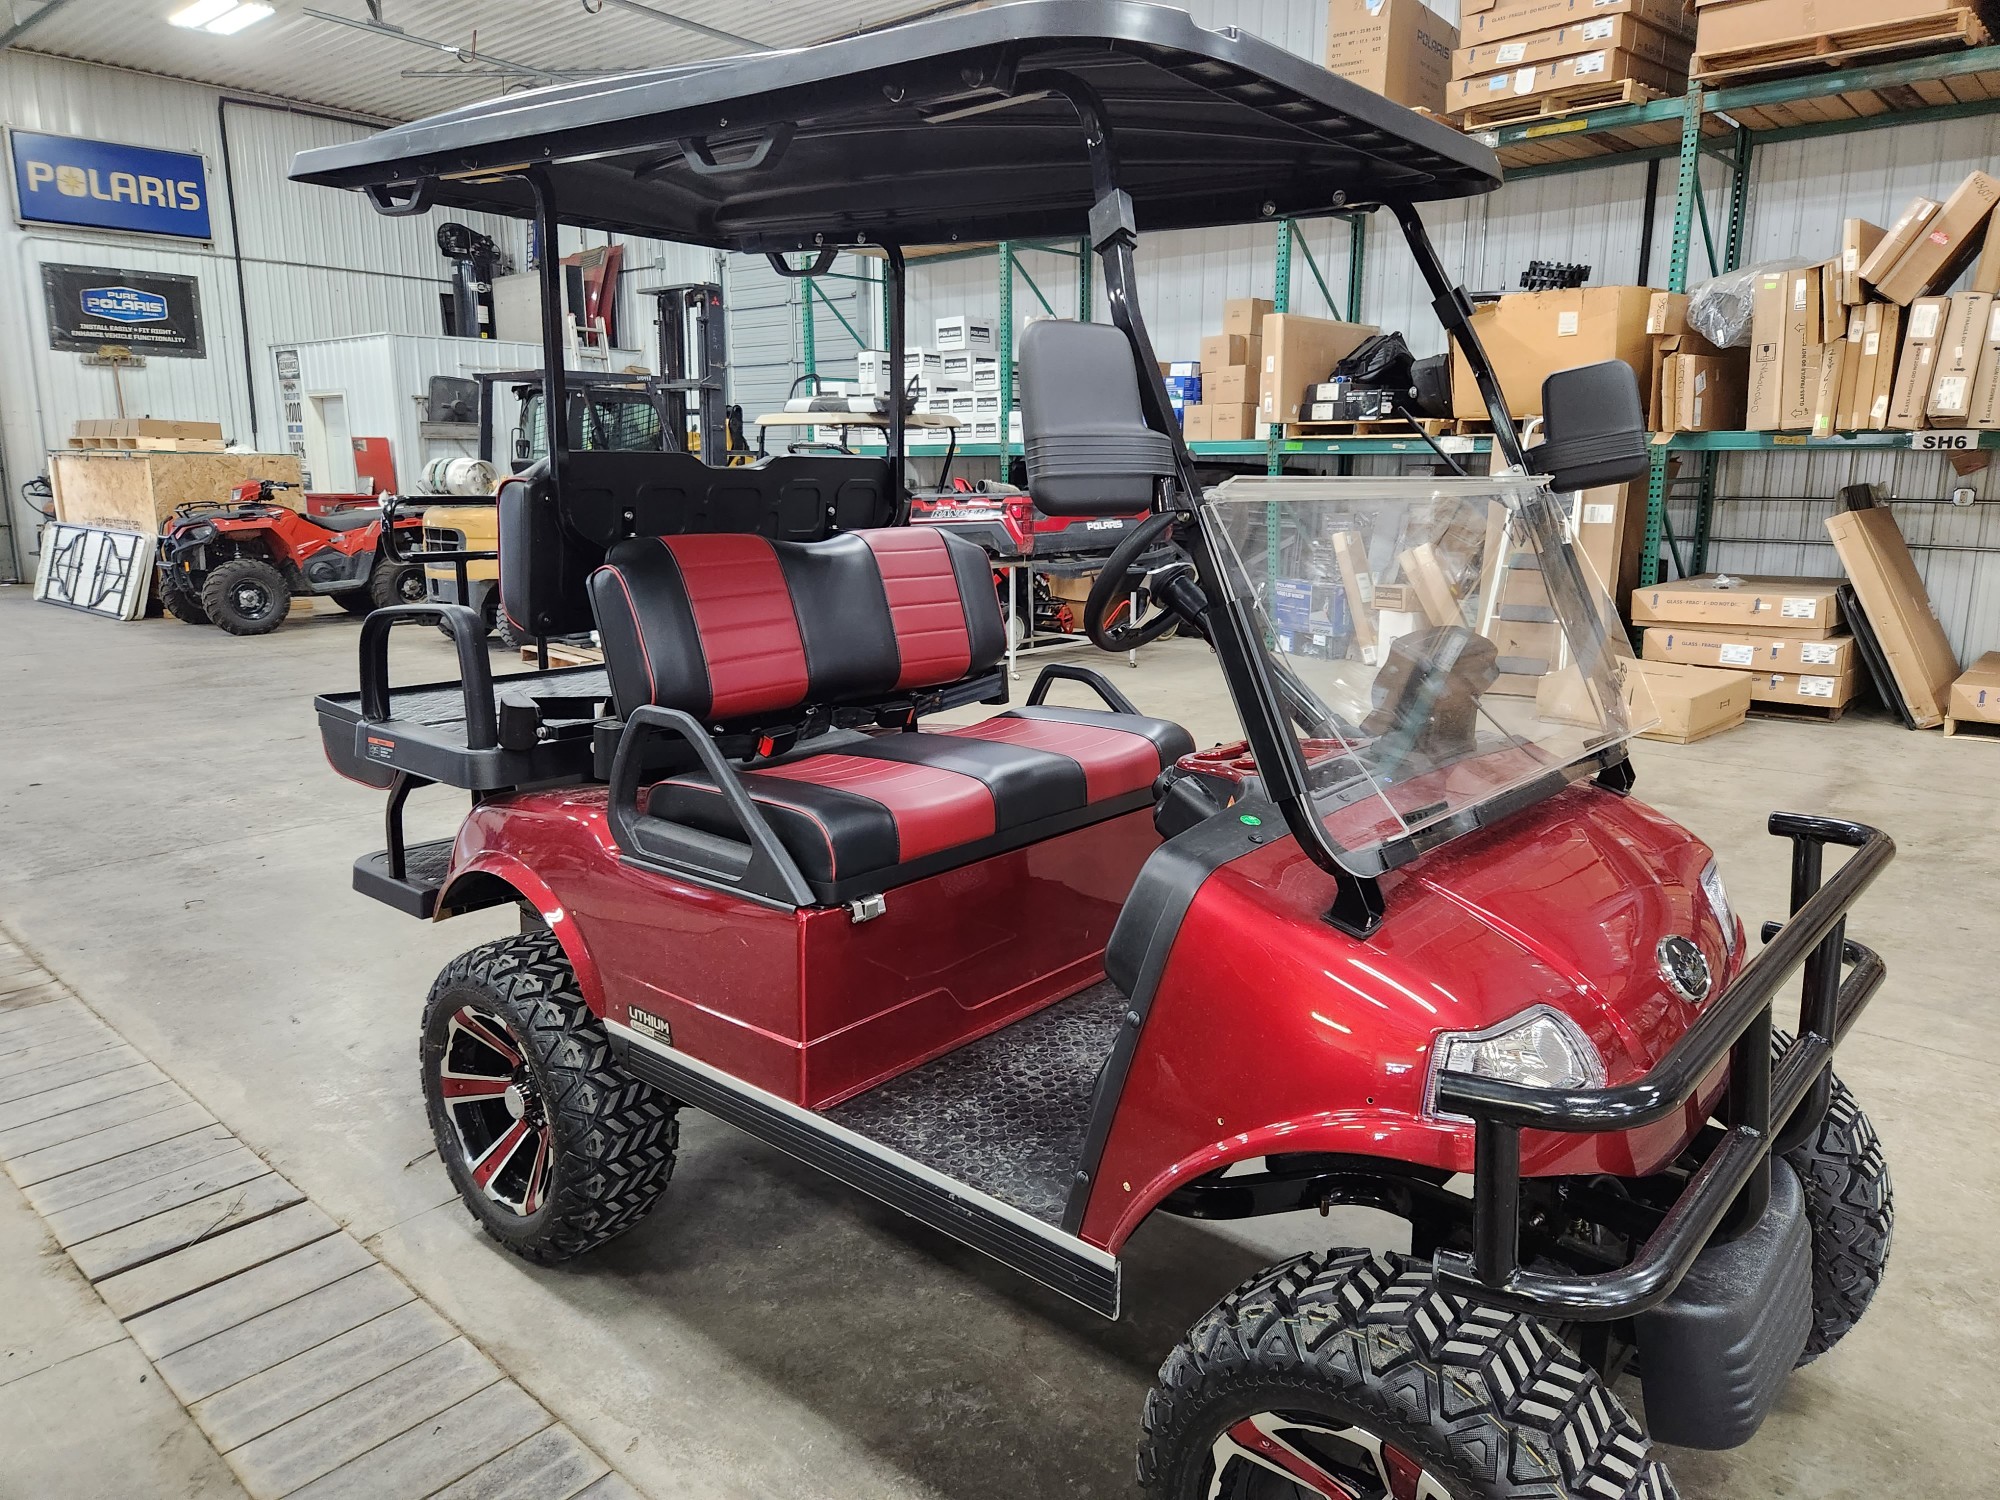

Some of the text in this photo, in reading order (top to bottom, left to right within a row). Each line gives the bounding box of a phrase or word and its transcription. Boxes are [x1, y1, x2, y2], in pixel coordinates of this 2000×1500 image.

[1417, 29, 1450, 60] POLARIS
[26, 160, 201, 211] POLARIS
[107, 291, 139, 301] PURE
[86, 297, 164, 313] POLARIS
[79, 323, 110, 332] INSTALL
[110, 325, 133, 333] EASILY
[104, 332, 133, 340] VEHICLE
[133, 334, 187, 343] FUNCTIONALITY
[1922, 435, 1968, 450] SH6
[931, 508, 987, 518] RANGER
[1086, 519, 1124, 531] POLARIS
[1375, 591, 1402, 599] POLARIS
[628, 1005, 670, 1035] LITHIUM
